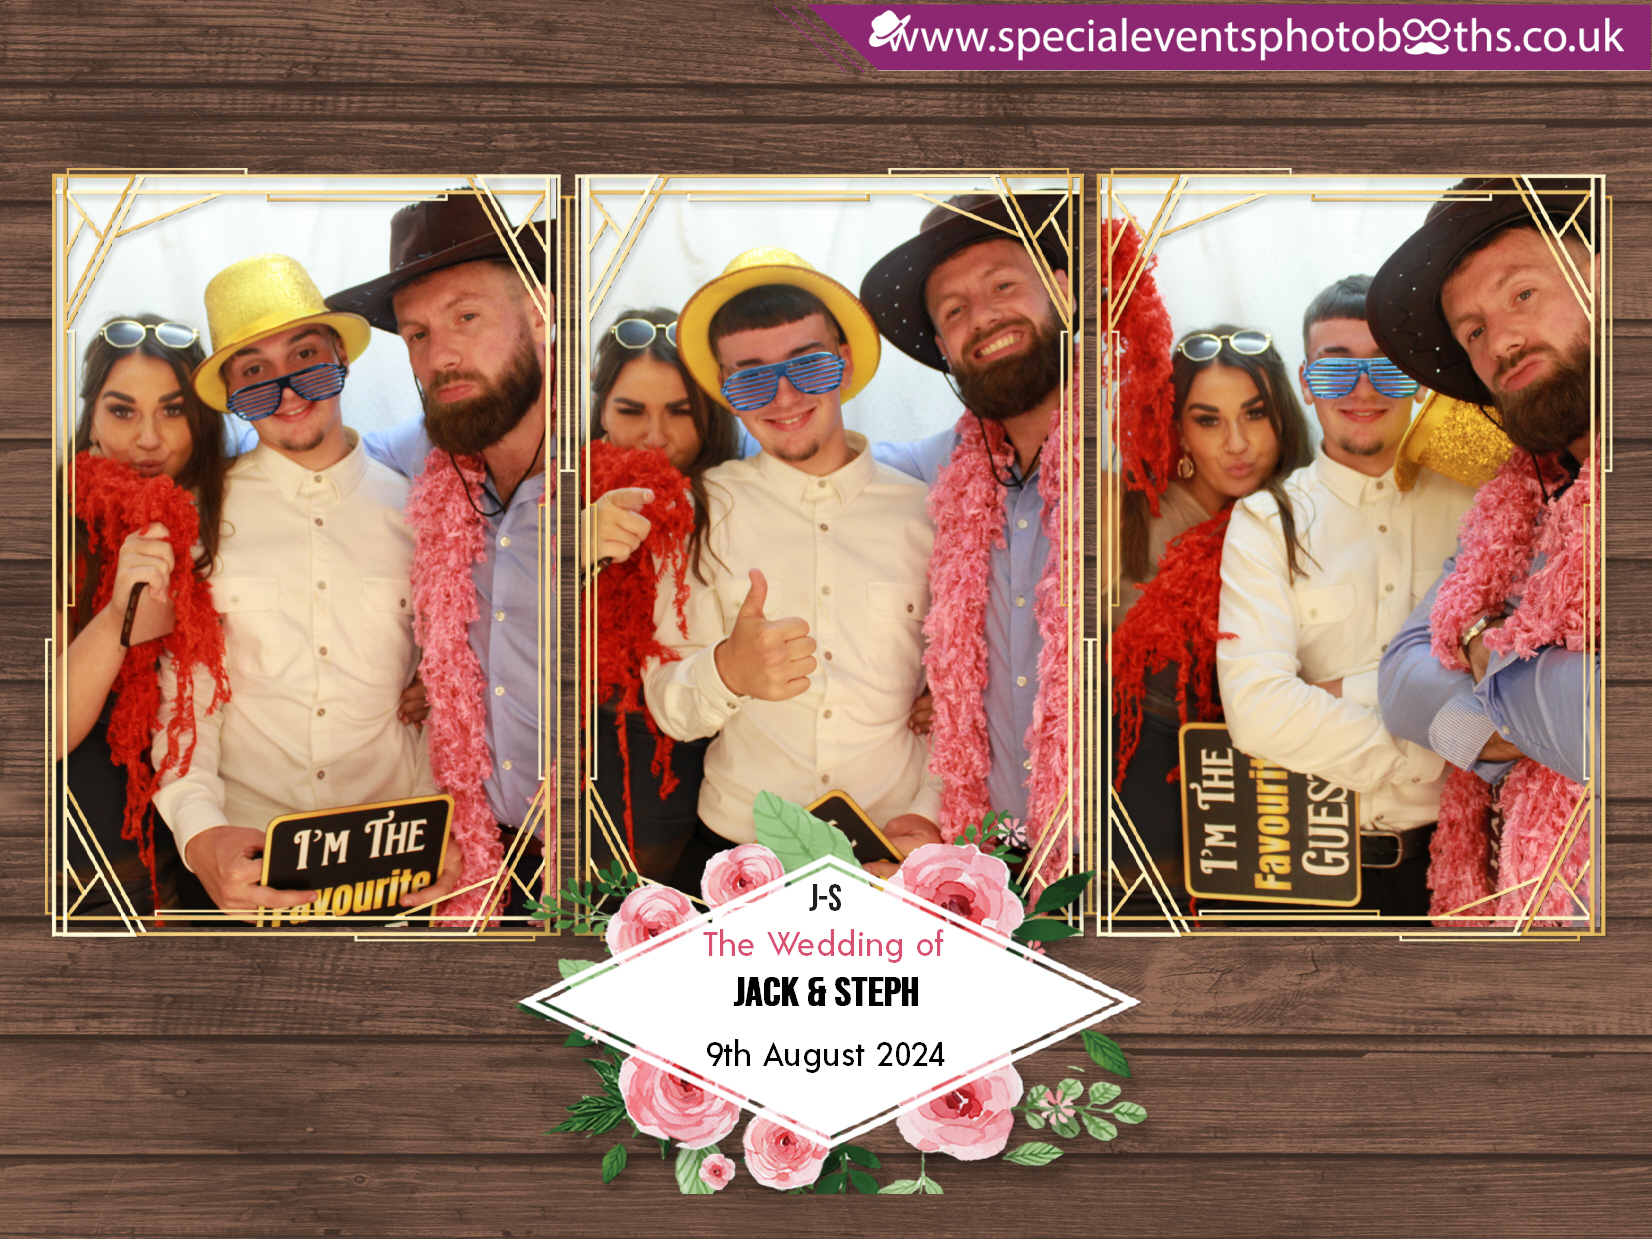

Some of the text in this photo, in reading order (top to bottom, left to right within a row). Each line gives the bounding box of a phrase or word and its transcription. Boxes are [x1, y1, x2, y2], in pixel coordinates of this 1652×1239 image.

[293, 810, 428, 870] I'M THE
[1189, 747, 1238, 875] I'M THE
[1248, 758, 1292, 891] Favourit
[1301, 773, 1350, 876] GUES
